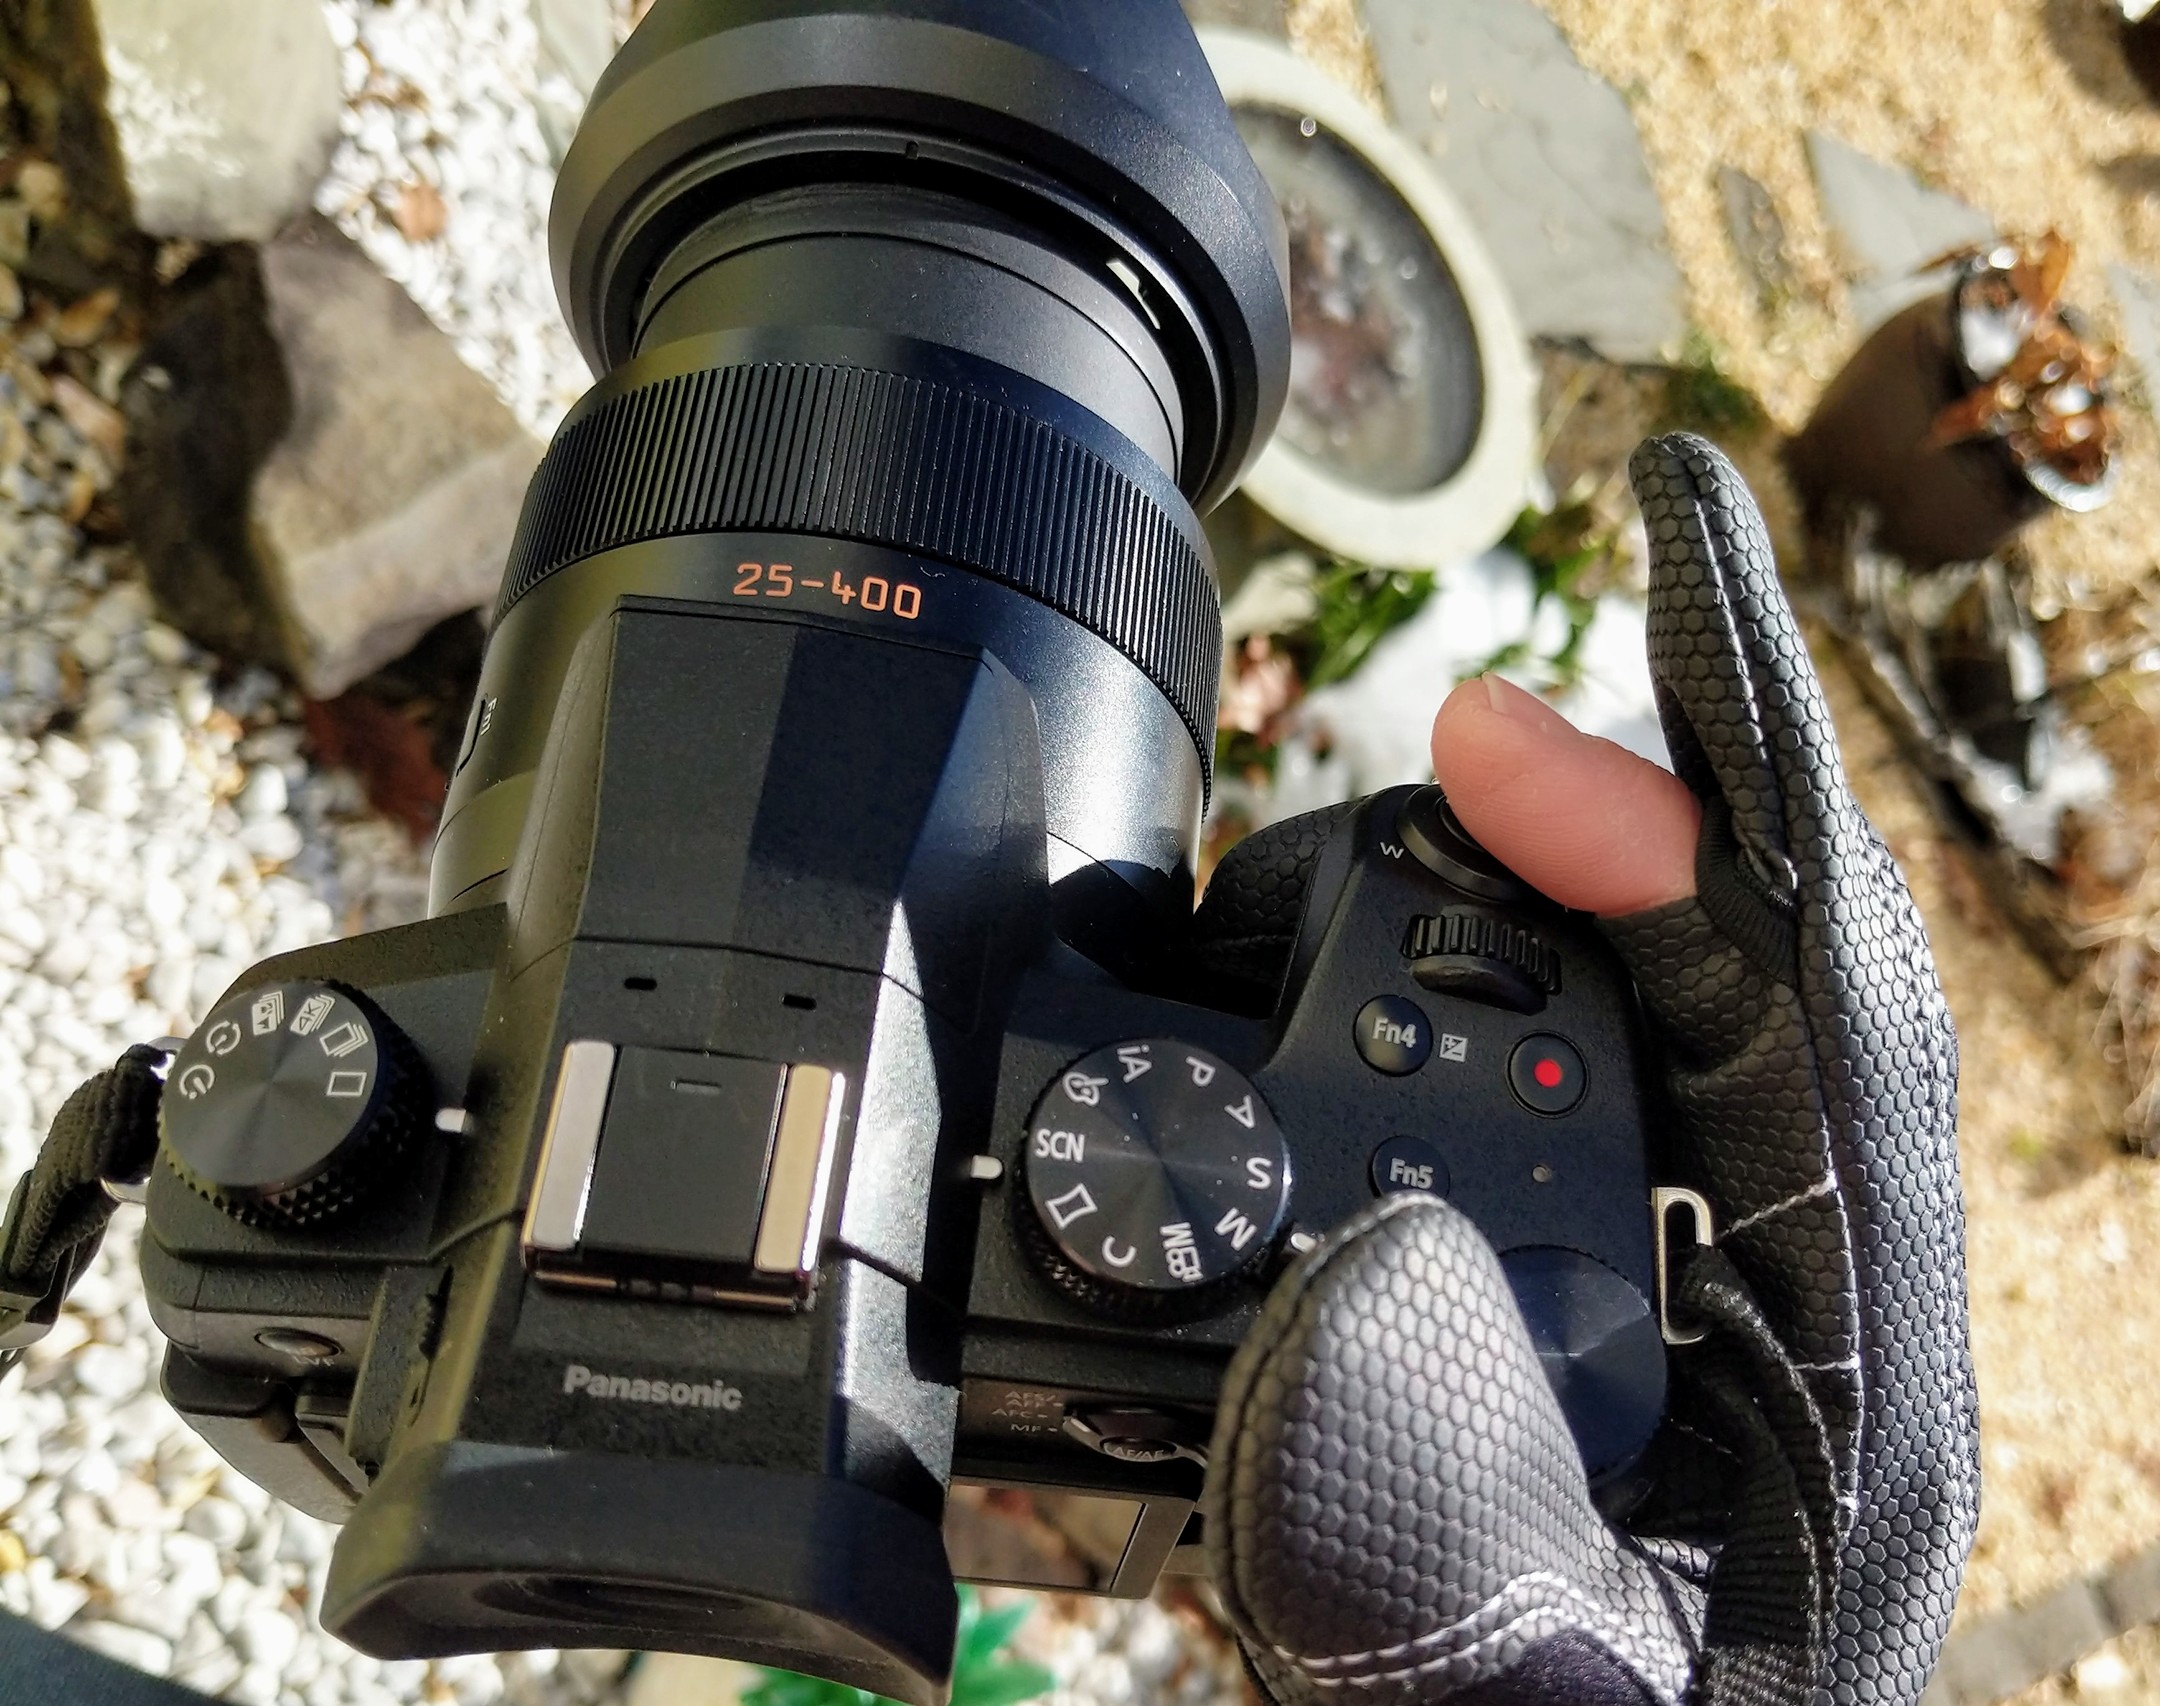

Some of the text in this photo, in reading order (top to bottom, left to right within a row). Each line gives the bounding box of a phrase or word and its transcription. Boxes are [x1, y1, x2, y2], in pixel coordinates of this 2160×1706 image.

[732, 562, 923, 620] 25-400
[1371, 1016, 1417, 1049] Fn4
[1185, 1055, 1216, 1087] P
[1223, 1094, 1256, 1129] A
[1035, 1128, 1086, 1163] SCN
[1245, 1156, 1273, 1190] S
[1388, 1157, 1434, 1191] Fn5
[1214, 1207, 1258, 1251] M
[1101, 1235, 1138, 1268] C
[563, 1363, 744, 1412] Panasonic
